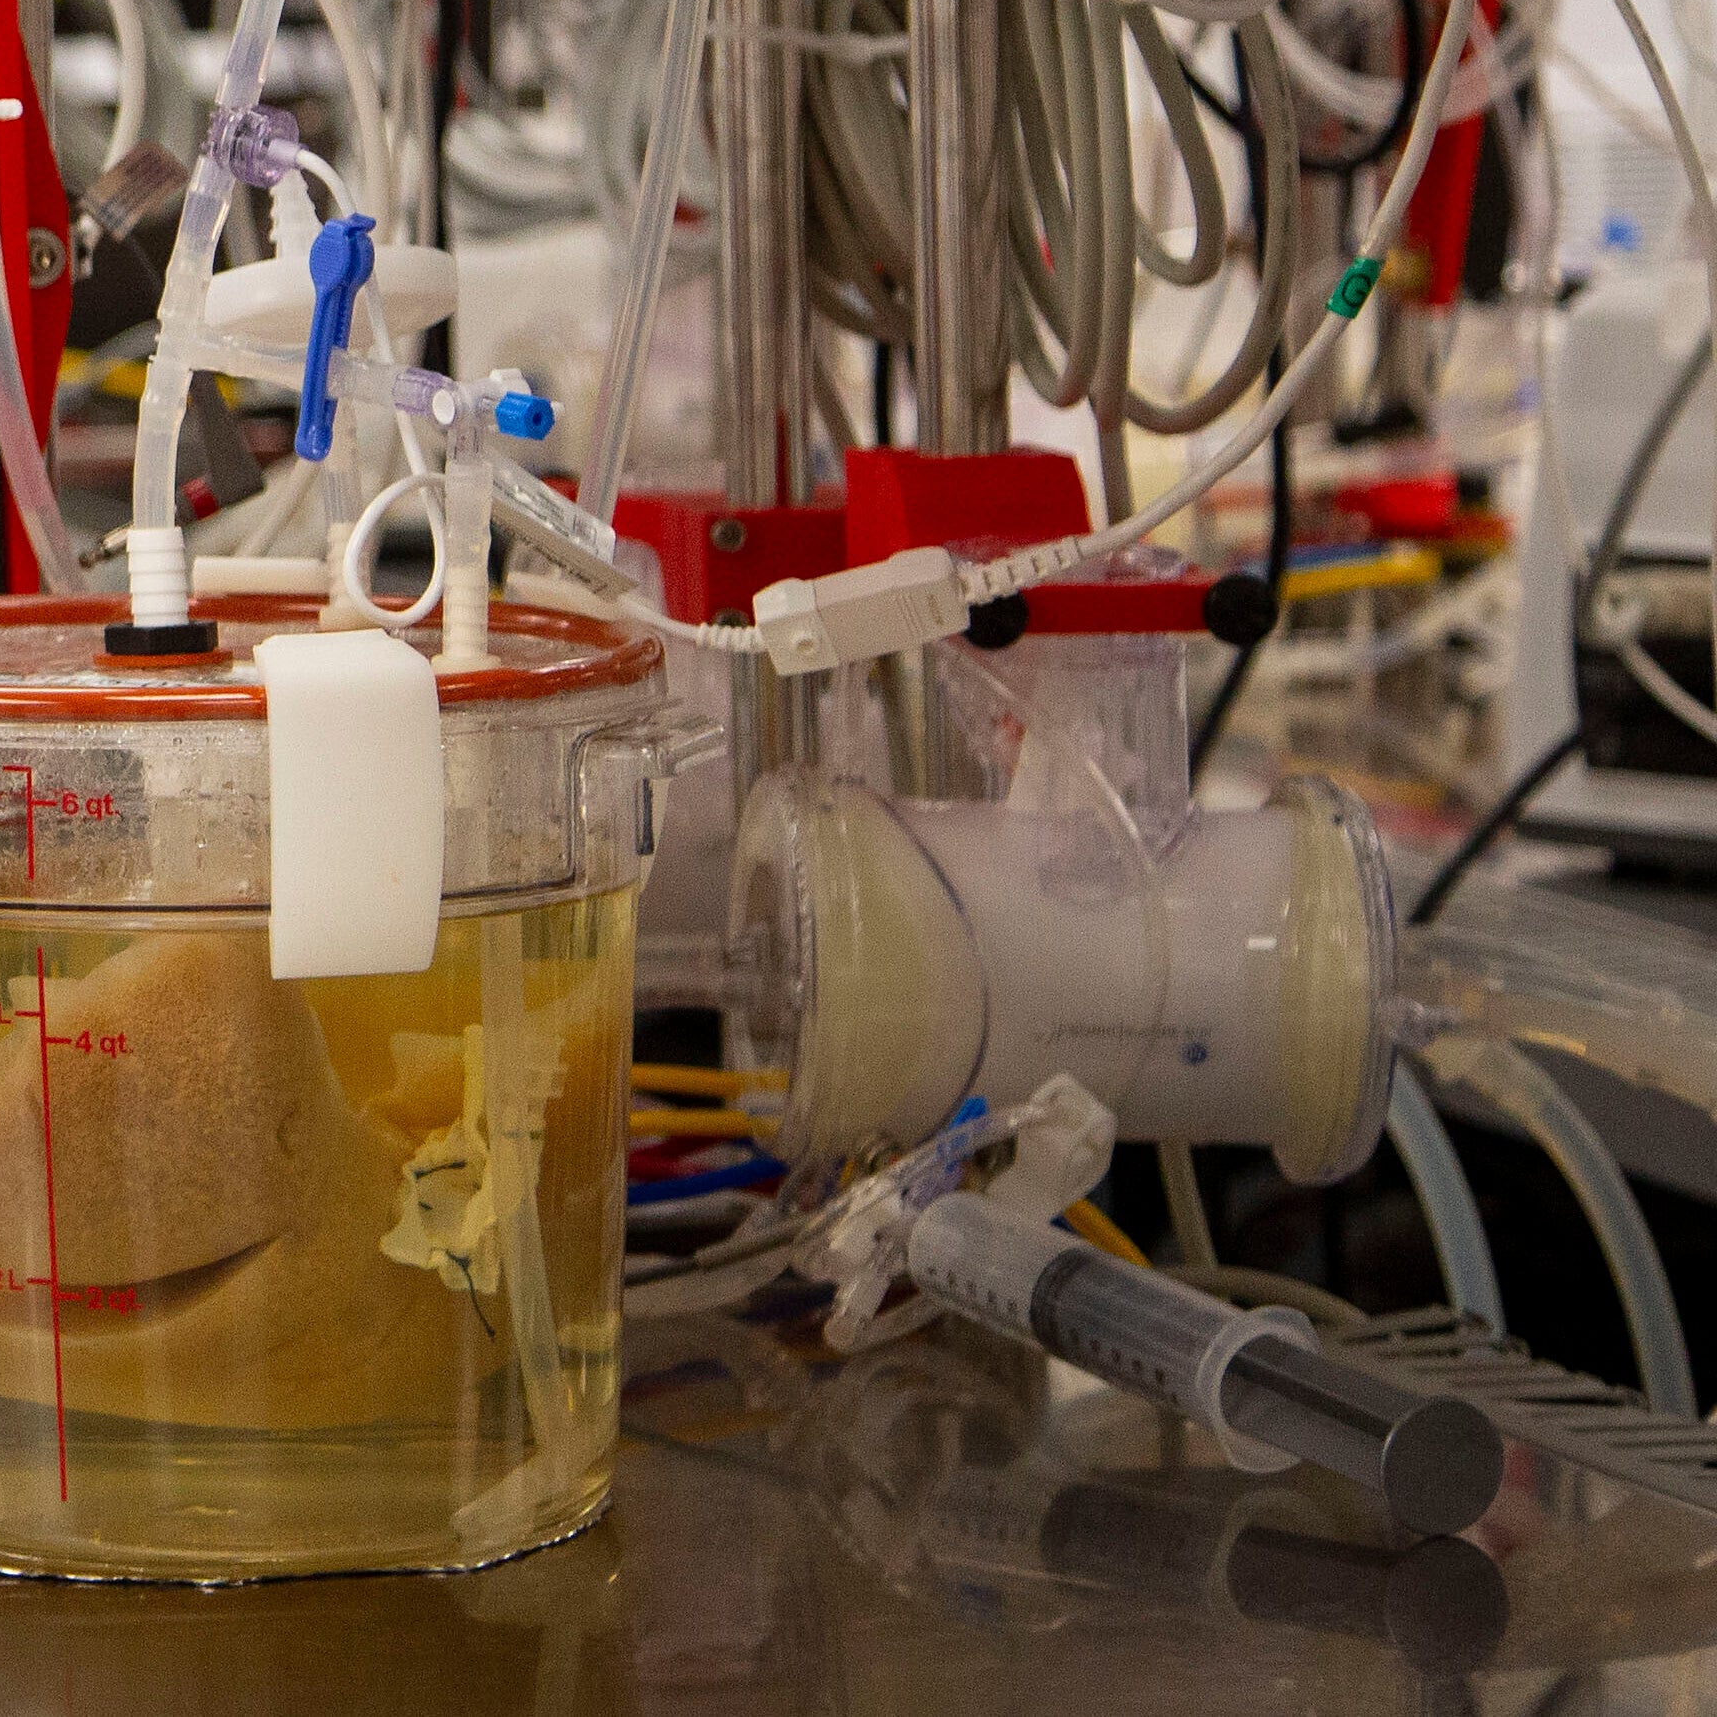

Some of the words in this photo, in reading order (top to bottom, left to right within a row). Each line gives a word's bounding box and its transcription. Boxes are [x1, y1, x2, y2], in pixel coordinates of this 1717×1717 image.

[1342, 273, 1372, 309] G
[62, 791, 79, 816] 6
[75, 1030, 93, 1055] 4
[86, 1286, 103, 1310] 2
